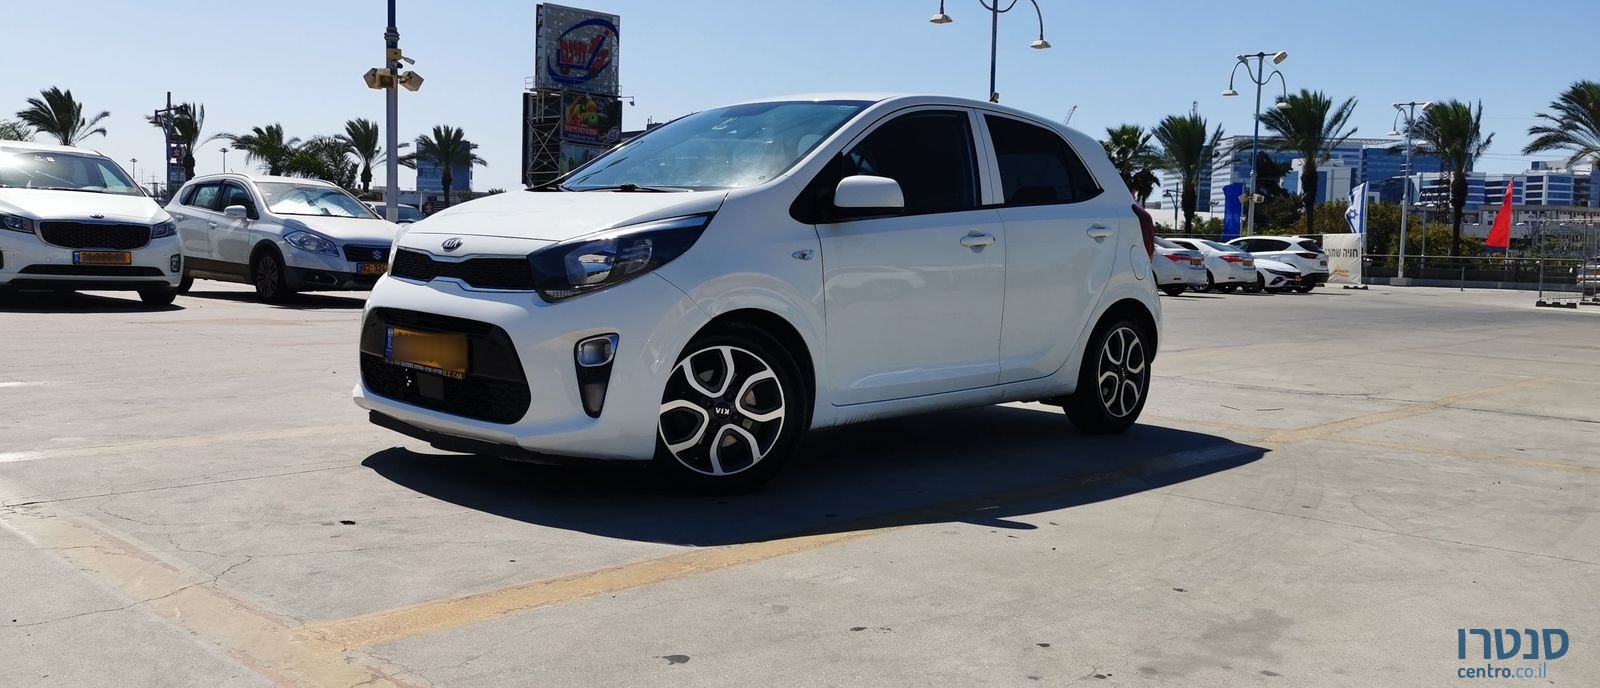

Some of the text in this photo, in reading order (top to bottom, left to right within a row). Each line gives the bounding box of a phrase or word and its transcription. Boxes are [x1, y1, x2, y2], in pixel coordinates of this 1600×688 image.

[443, 239, 460, 248] KIA
[1342, 248, 1359, 258] חניה
[715, 407, 730, 415] KIA
